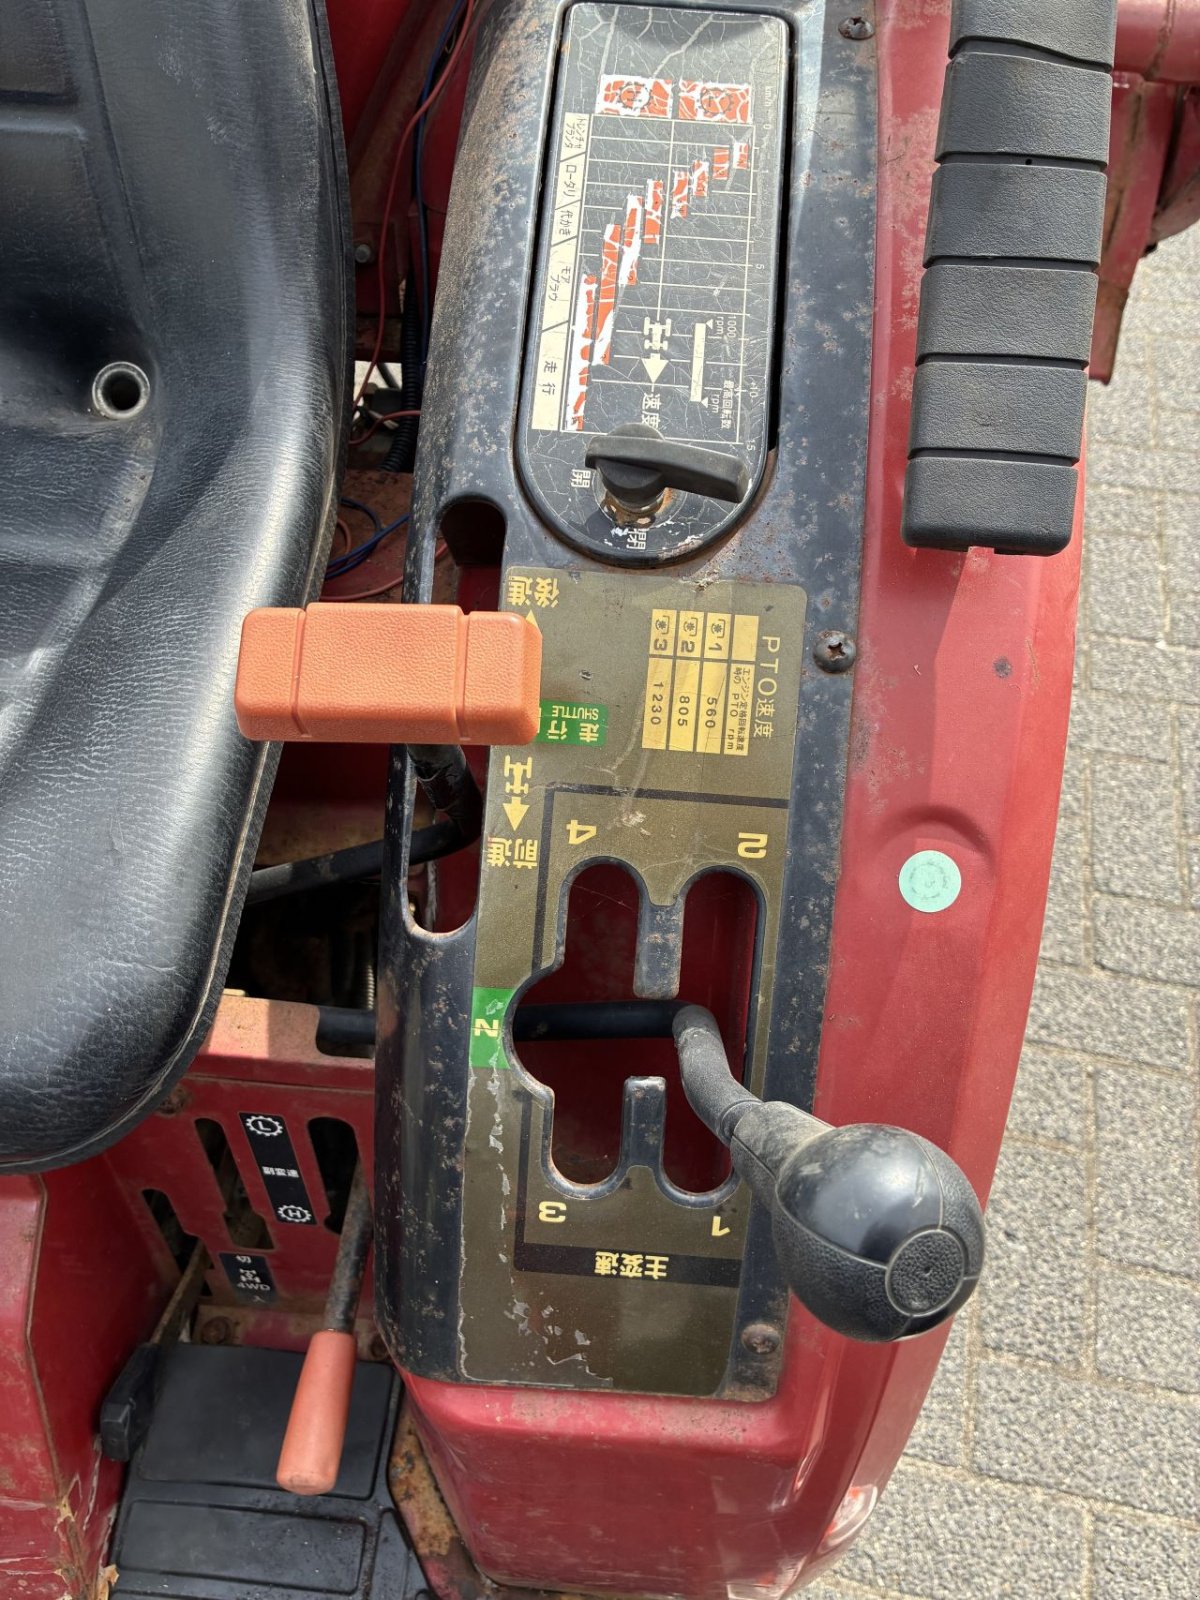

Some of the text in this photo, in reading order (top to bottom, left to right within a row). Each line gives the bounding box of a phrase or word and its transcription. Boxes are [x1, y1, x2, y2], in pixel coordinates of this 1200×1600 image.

[764, 85, 773, 107] km/h
[562, 164, 577, 197] ロータリ
[558, 210, 574, 236] 代かき
[559, 265, 571, 284] モア
[715, 316, 724, 335] rpm
[727, 315, 737, 338] 1000
[543, 360, 558, 396] 走行
[641, 392, 660, 429] 速度
[712, 393, 720, 414] rpm
[720, 380, 735, 429] 最高回転数
[571, 468, 591, 489] 開
[626, 527, 647, 550] 閉
[507, 575, 560, 608] 後進
[650, 638, 668, 726] 3 1230
[677, 640, 696, 727] 2 805
[705, 642, 723, 729] 1 560
[753, 635, 780, 738] PTO速度
[551, 705, 599, 720] SHUTTLE
[726, 667, 743, 750] 時の PTO rpm
[736, 667, 751, 752] エンジン定格回転速度
[546, 719, 600, 743] 走行
[566, 819, 597, 845] 4
[486, 836, 538, 870] 前進
[737, 832, 769, 859] 2
[473, 1018, 500, 1038] N
[257, 1120, 271, 1131] L
[288, 1209, 301, 1218] H
[538, 1200, 567, 1223] 3
[710, 1215, 731, 1237] 1
[594, 1250, 670, 1280] 主変速
[237, 1282, 271, 1292] 4WD
